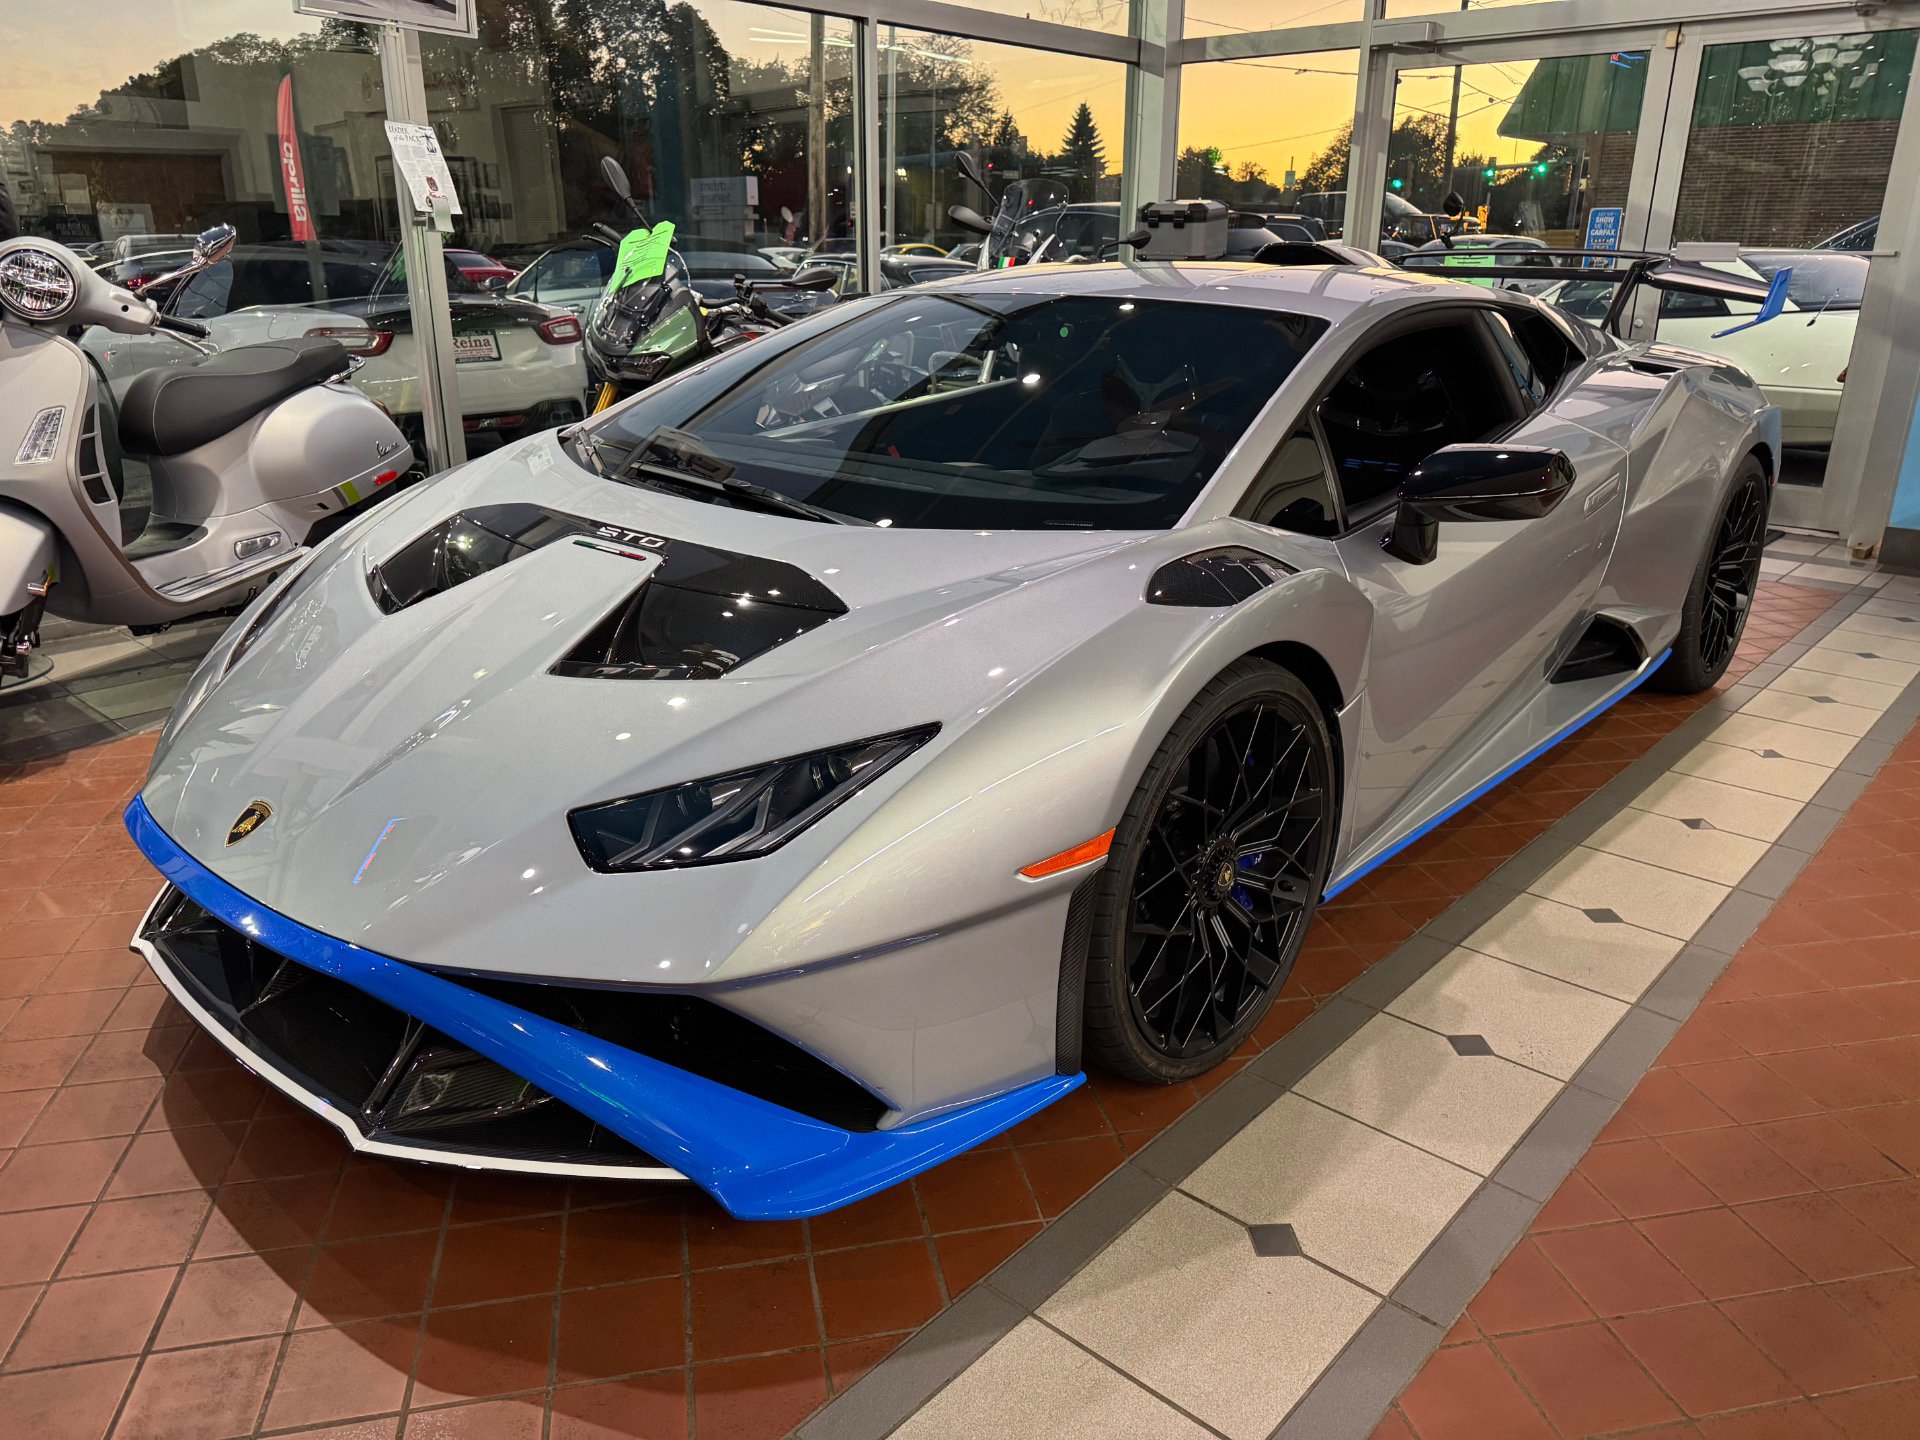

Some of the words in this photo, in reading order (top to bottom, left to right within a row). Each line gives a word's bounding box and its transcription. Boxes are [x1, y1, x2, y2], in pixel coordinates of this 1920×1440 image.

[283, 141, 307, 222] aprilia
[1595, 216, 1615, 224] SHOW
[453, 338, 492, 349] Reina
[596, 526, 666, 548] STO
